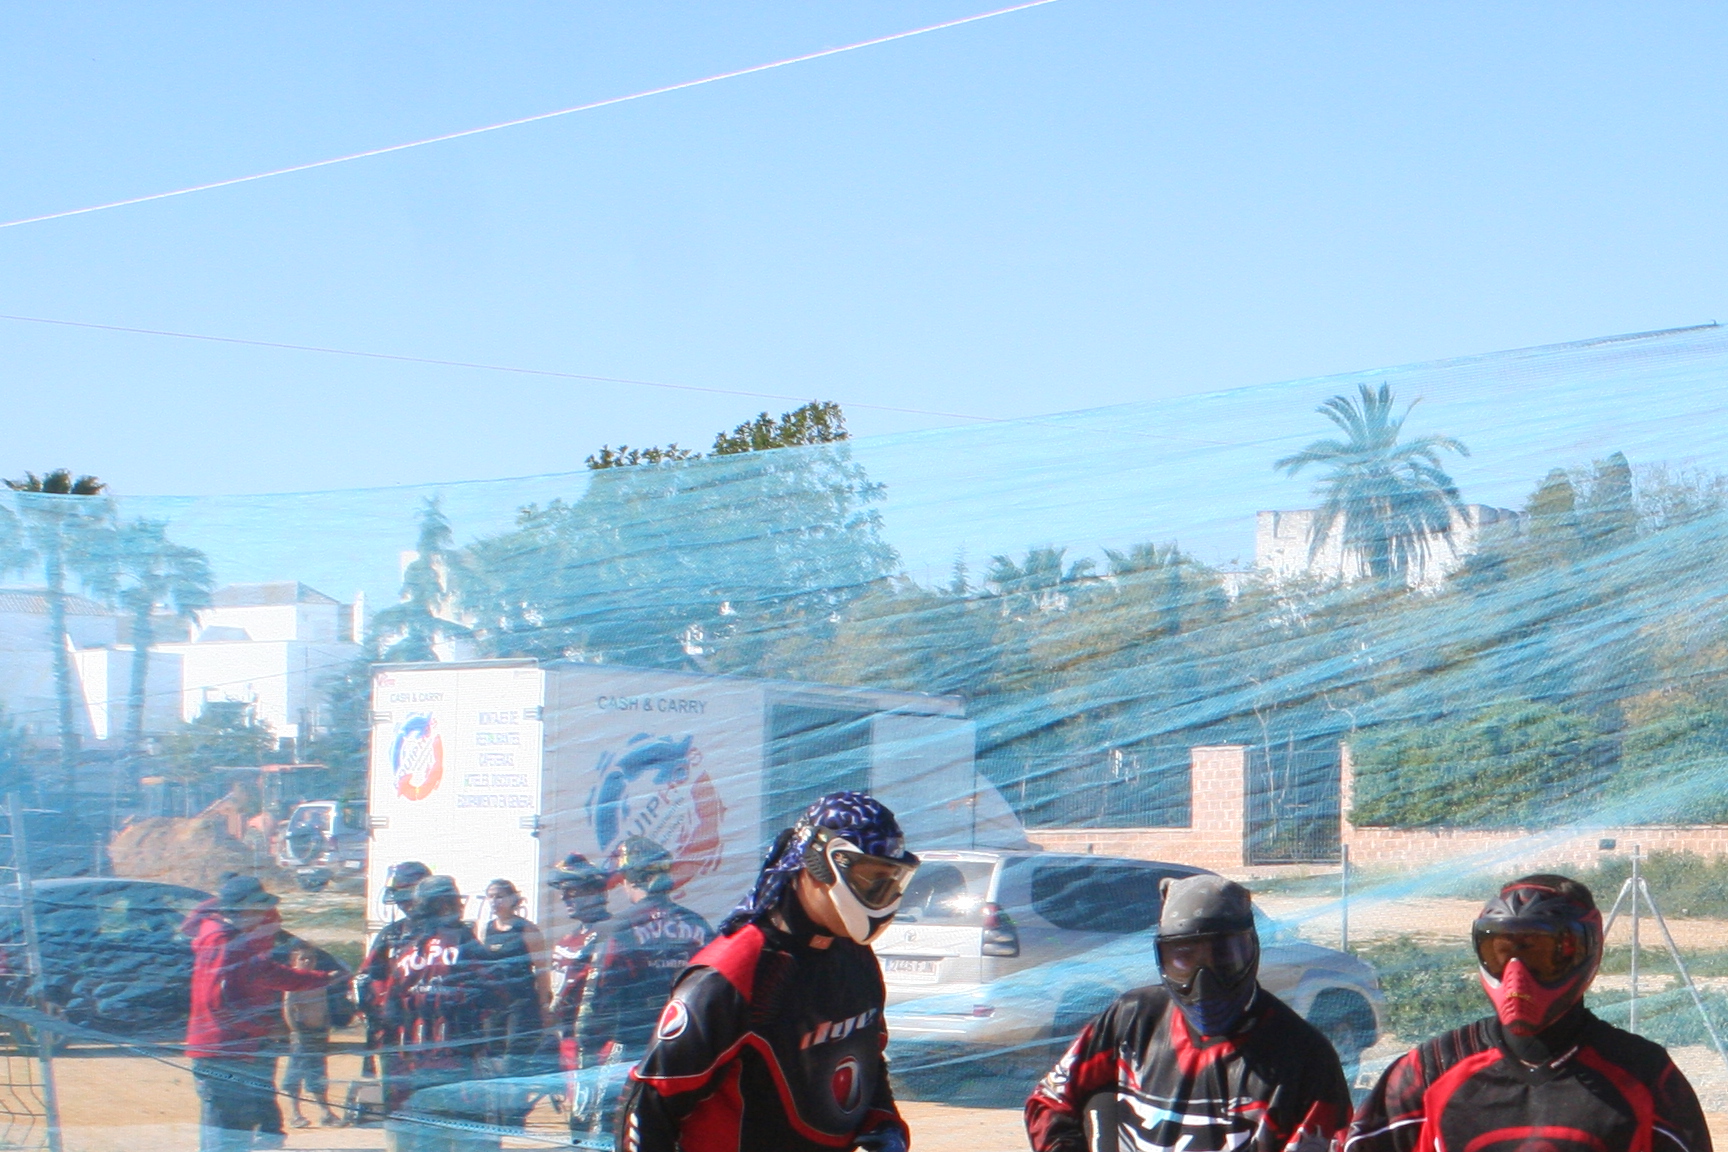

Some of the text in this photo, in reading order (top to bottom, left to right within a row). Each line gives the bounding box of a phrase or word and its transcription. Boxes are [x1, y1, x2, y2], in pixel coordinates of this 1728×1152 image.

[597, 695, 708, 714] CASH & CARRY
[396, 944, 460, 978] TOPO
